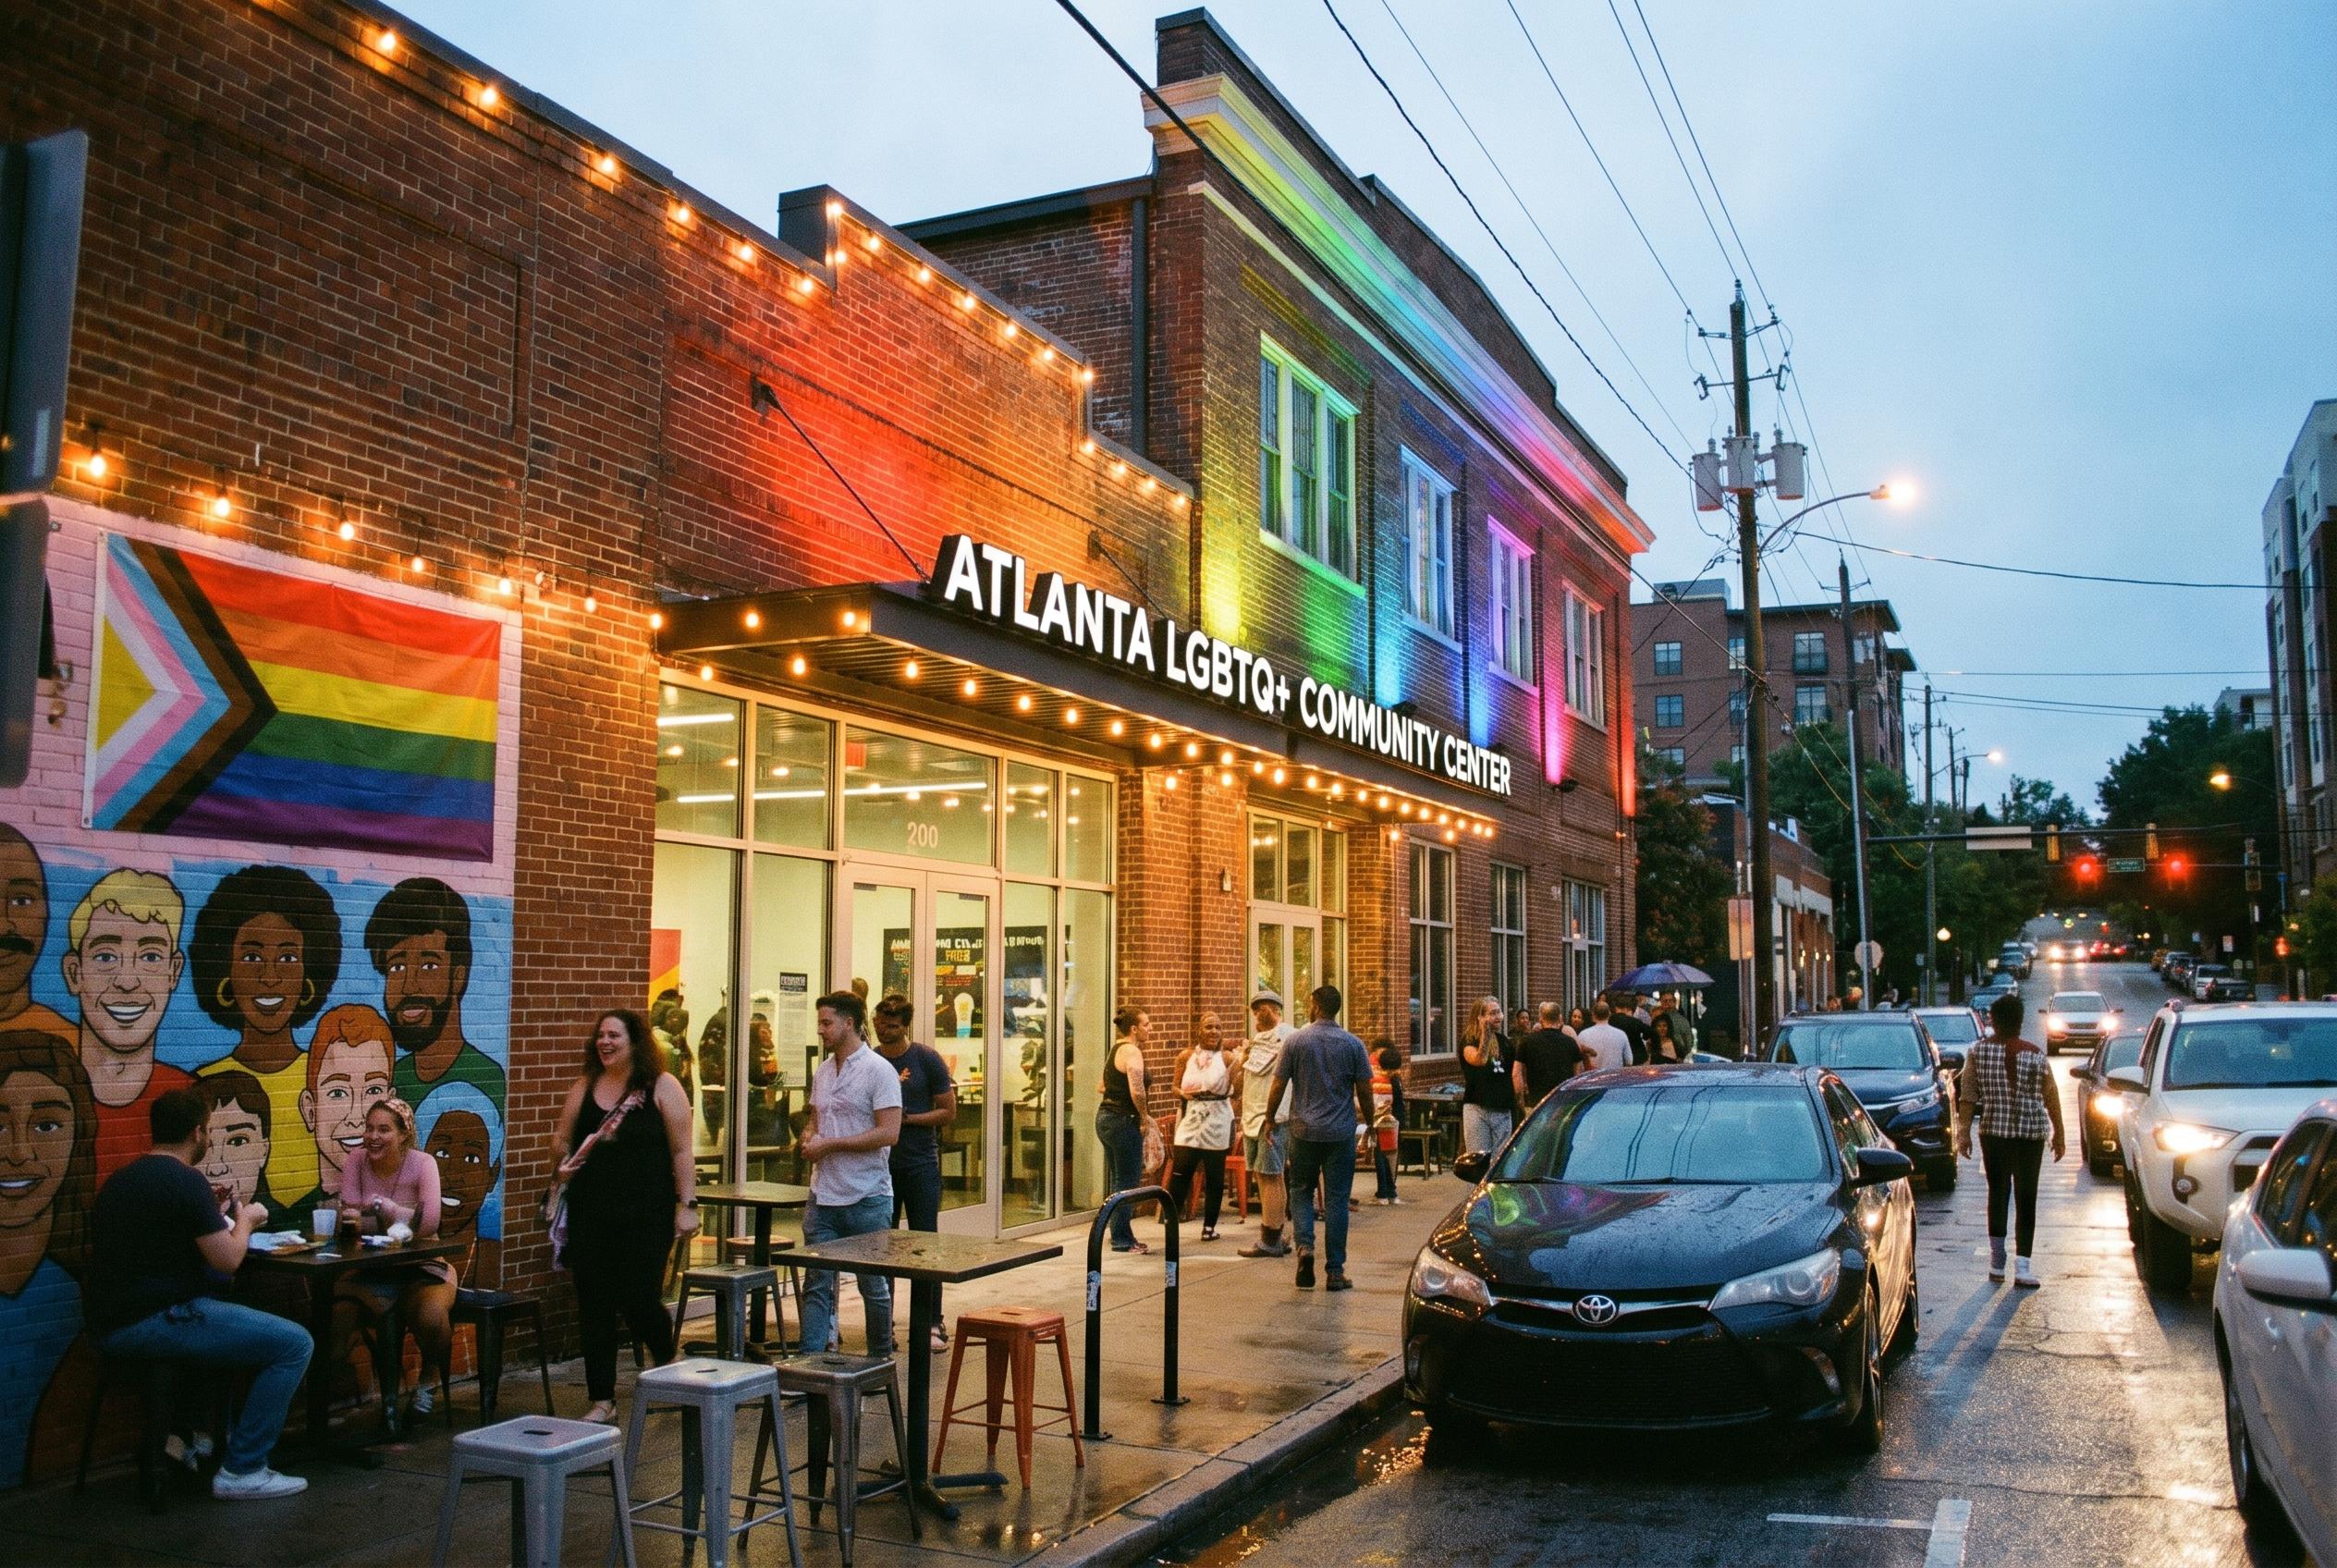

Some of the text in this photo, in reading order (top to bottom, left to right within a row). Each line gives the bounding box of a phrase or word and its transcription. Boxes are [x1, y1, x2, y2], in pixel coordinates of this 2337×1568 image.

[944, 534, 1511, 797] ATLANTA LGBTQ+ COMMUNITY CENTER
[907, 821, 938, 849] 200
